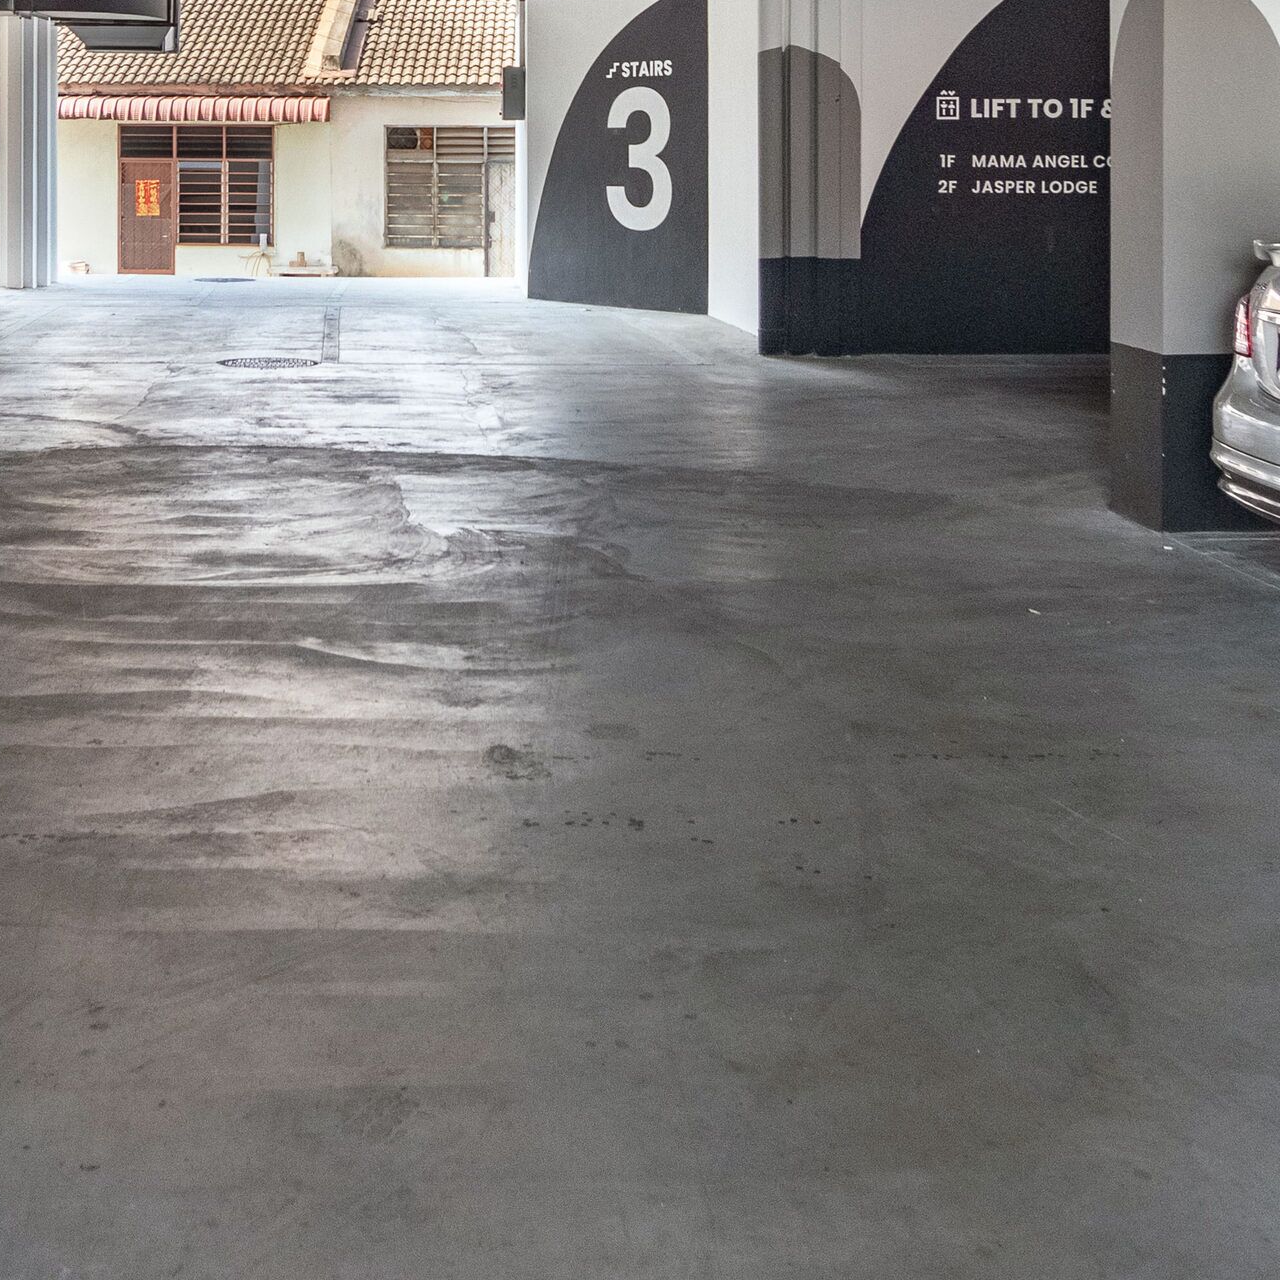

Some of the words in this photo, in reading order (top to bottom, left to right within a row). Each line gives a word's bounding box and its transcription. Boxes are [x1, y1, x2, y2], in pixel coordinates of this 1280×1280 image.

[621, 59, 673, 78] STAIRS
[970, 98, 1021, 119] LIFT
[1027, 98, 1063, 119] TO
[1069, 98, 1094, 119] 1F
[605, 86, 673, 232] 3
[939, 154, 957, 168] 1F
[971, 154, 1027, 168] MAMA
[1032, 154, 1088, 168] ANGEL
[938, 179, 958, 194] 2F
[971, 179, 1036, 194] JASPER
[1041, 179, 1098, 194] LODGE
